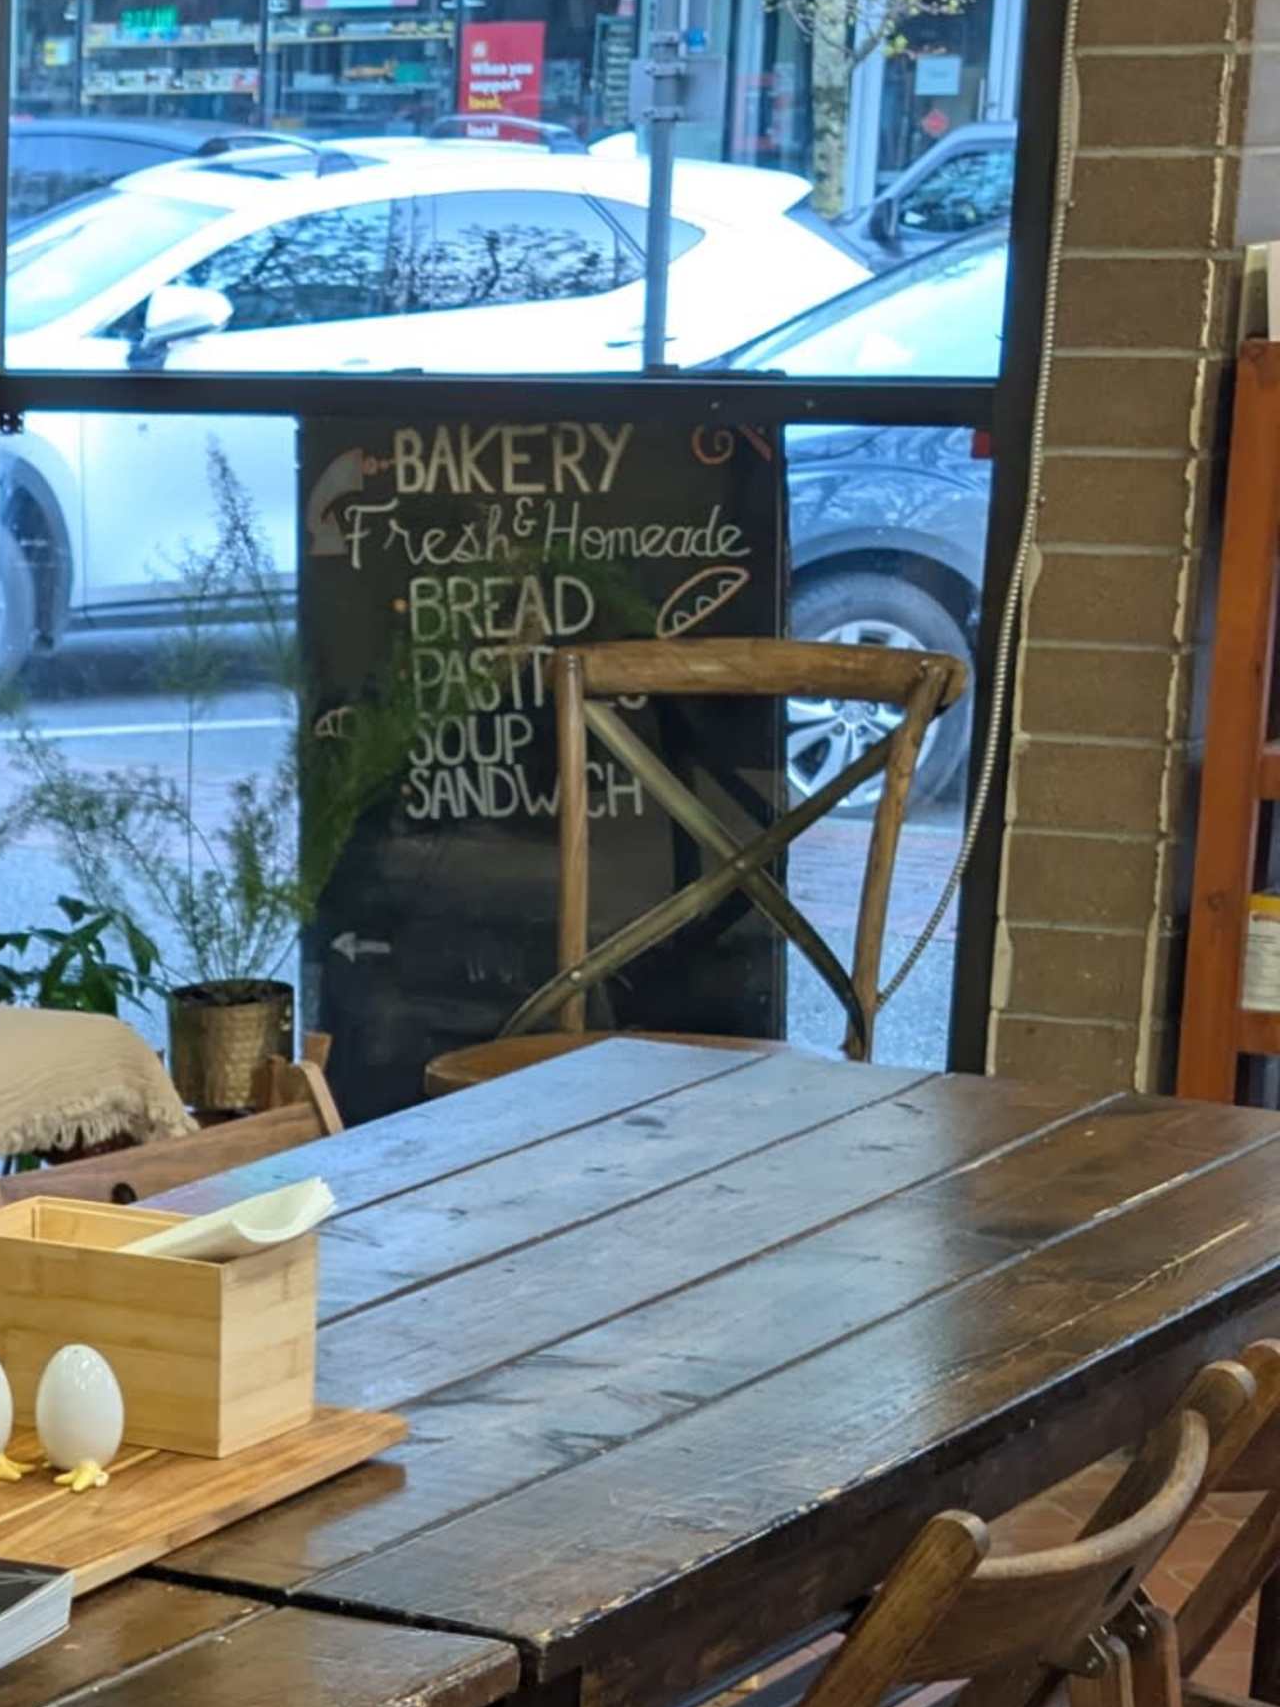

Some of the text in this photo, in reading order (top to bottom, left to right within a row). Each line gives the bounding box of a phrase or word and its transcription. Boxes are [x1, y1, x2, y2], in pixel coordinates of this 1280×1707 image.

[394, 421, 634, 493] BAKERY
[343, 496, 752, 570] Fresh & Homeade
[409, 574, 596, 641] BREAD
[408, 712, 533, 767] SOUP
[406, 762, 644, 820] SANDWCH
